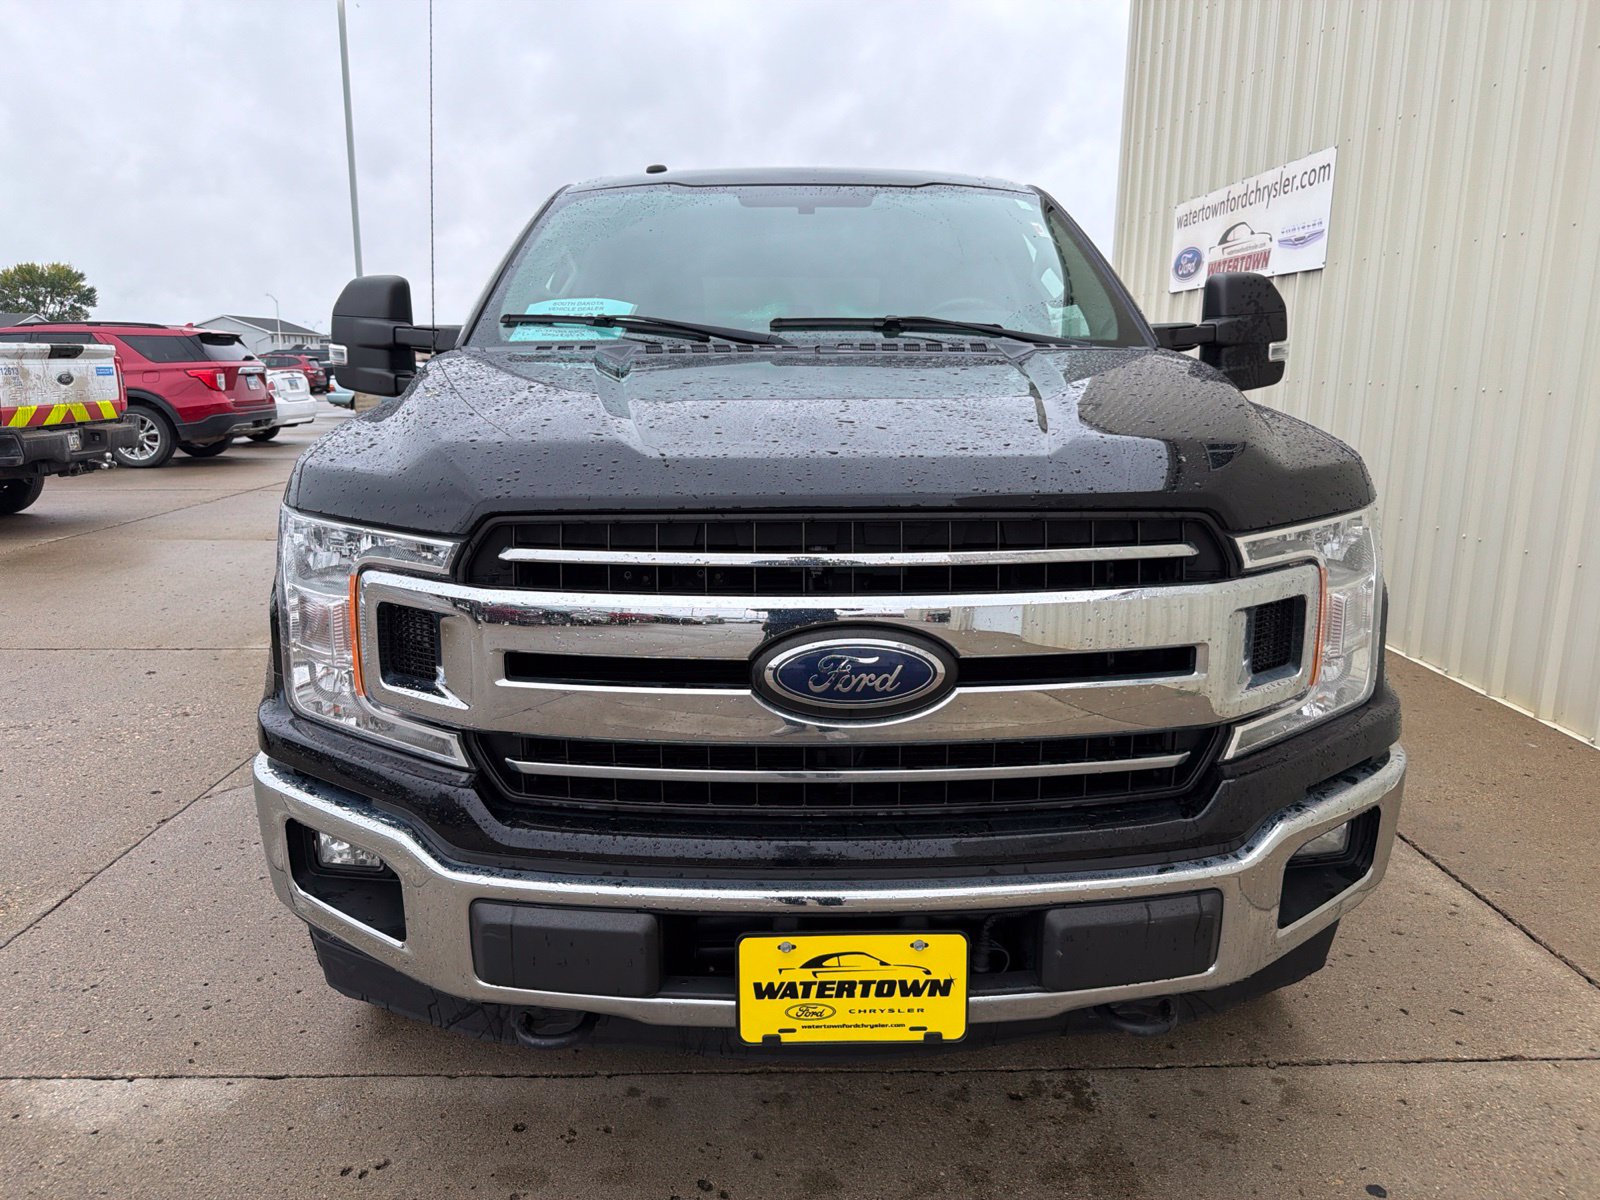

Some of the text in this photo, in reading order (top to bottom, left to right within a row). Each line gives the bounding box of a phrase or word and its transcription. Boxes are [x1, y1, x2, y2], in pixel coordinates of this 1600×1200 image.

[1176, 162, 1331, 230] watertownfordchrysler.com
[1177, 253, 1198, 276] Ford
[1207, 248, 1272, 277] WATERTOWN
[808, 654, 904, 693] Ford
[753, 978, 953, 1000] WATERTOWN
[795, 1006, 826, 1018] Ford
